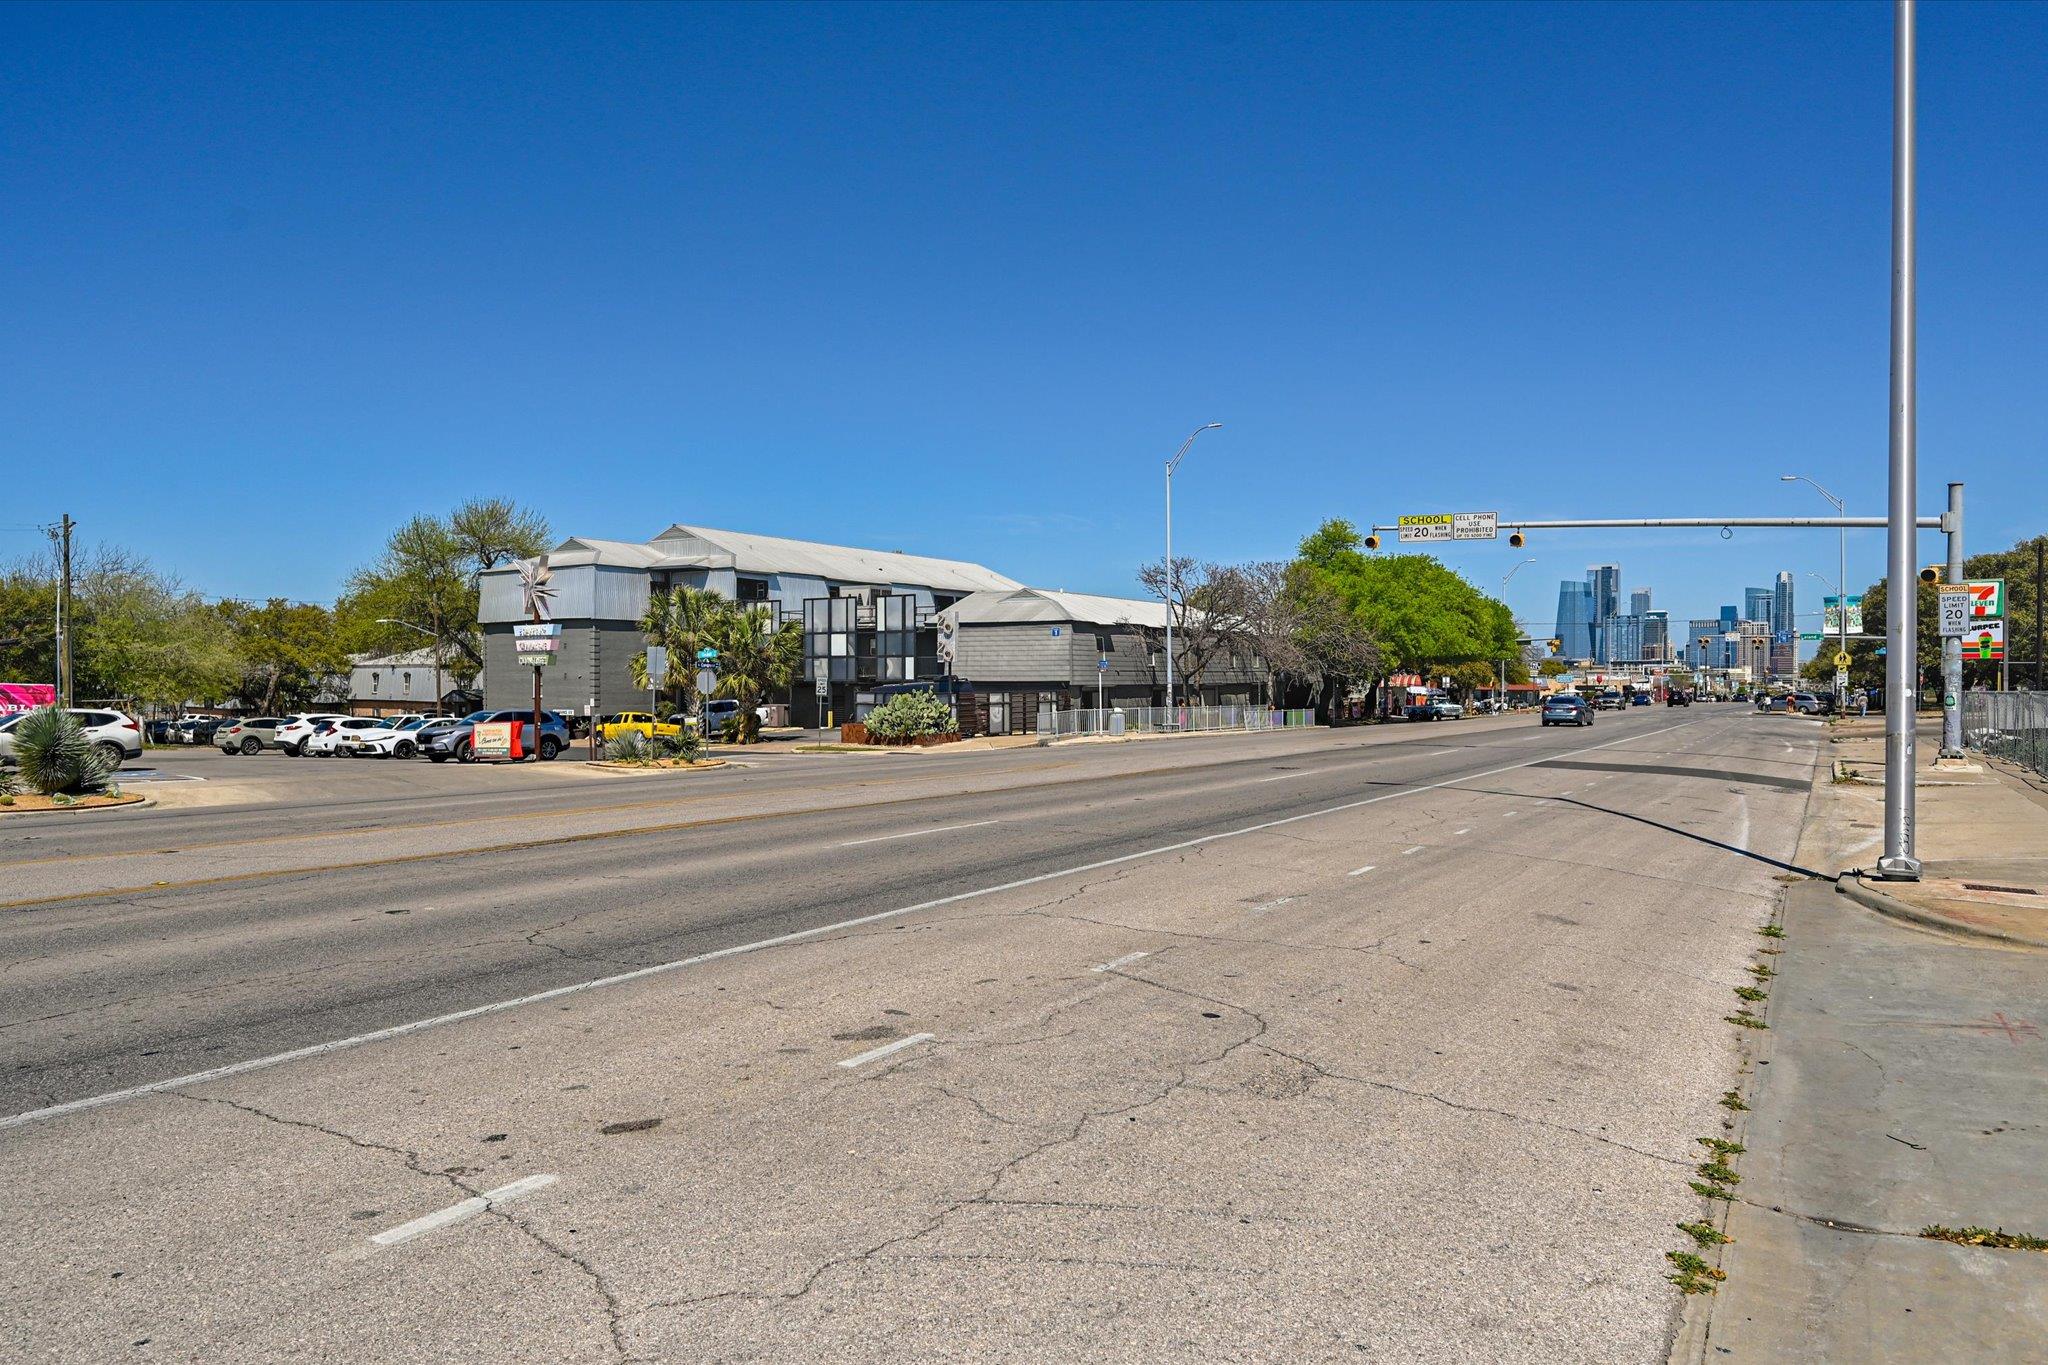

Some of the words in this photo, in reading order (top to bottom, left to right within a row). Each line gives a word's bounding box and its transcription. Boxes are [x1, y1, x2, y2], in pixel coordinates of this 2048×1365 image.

[1403, 515, 1447, 525] SCHOOL
[1414, 527, 1429, 537] 20
[1969, 585, 1995, 616] 7
[1945, 609, 1963, 619] 20
